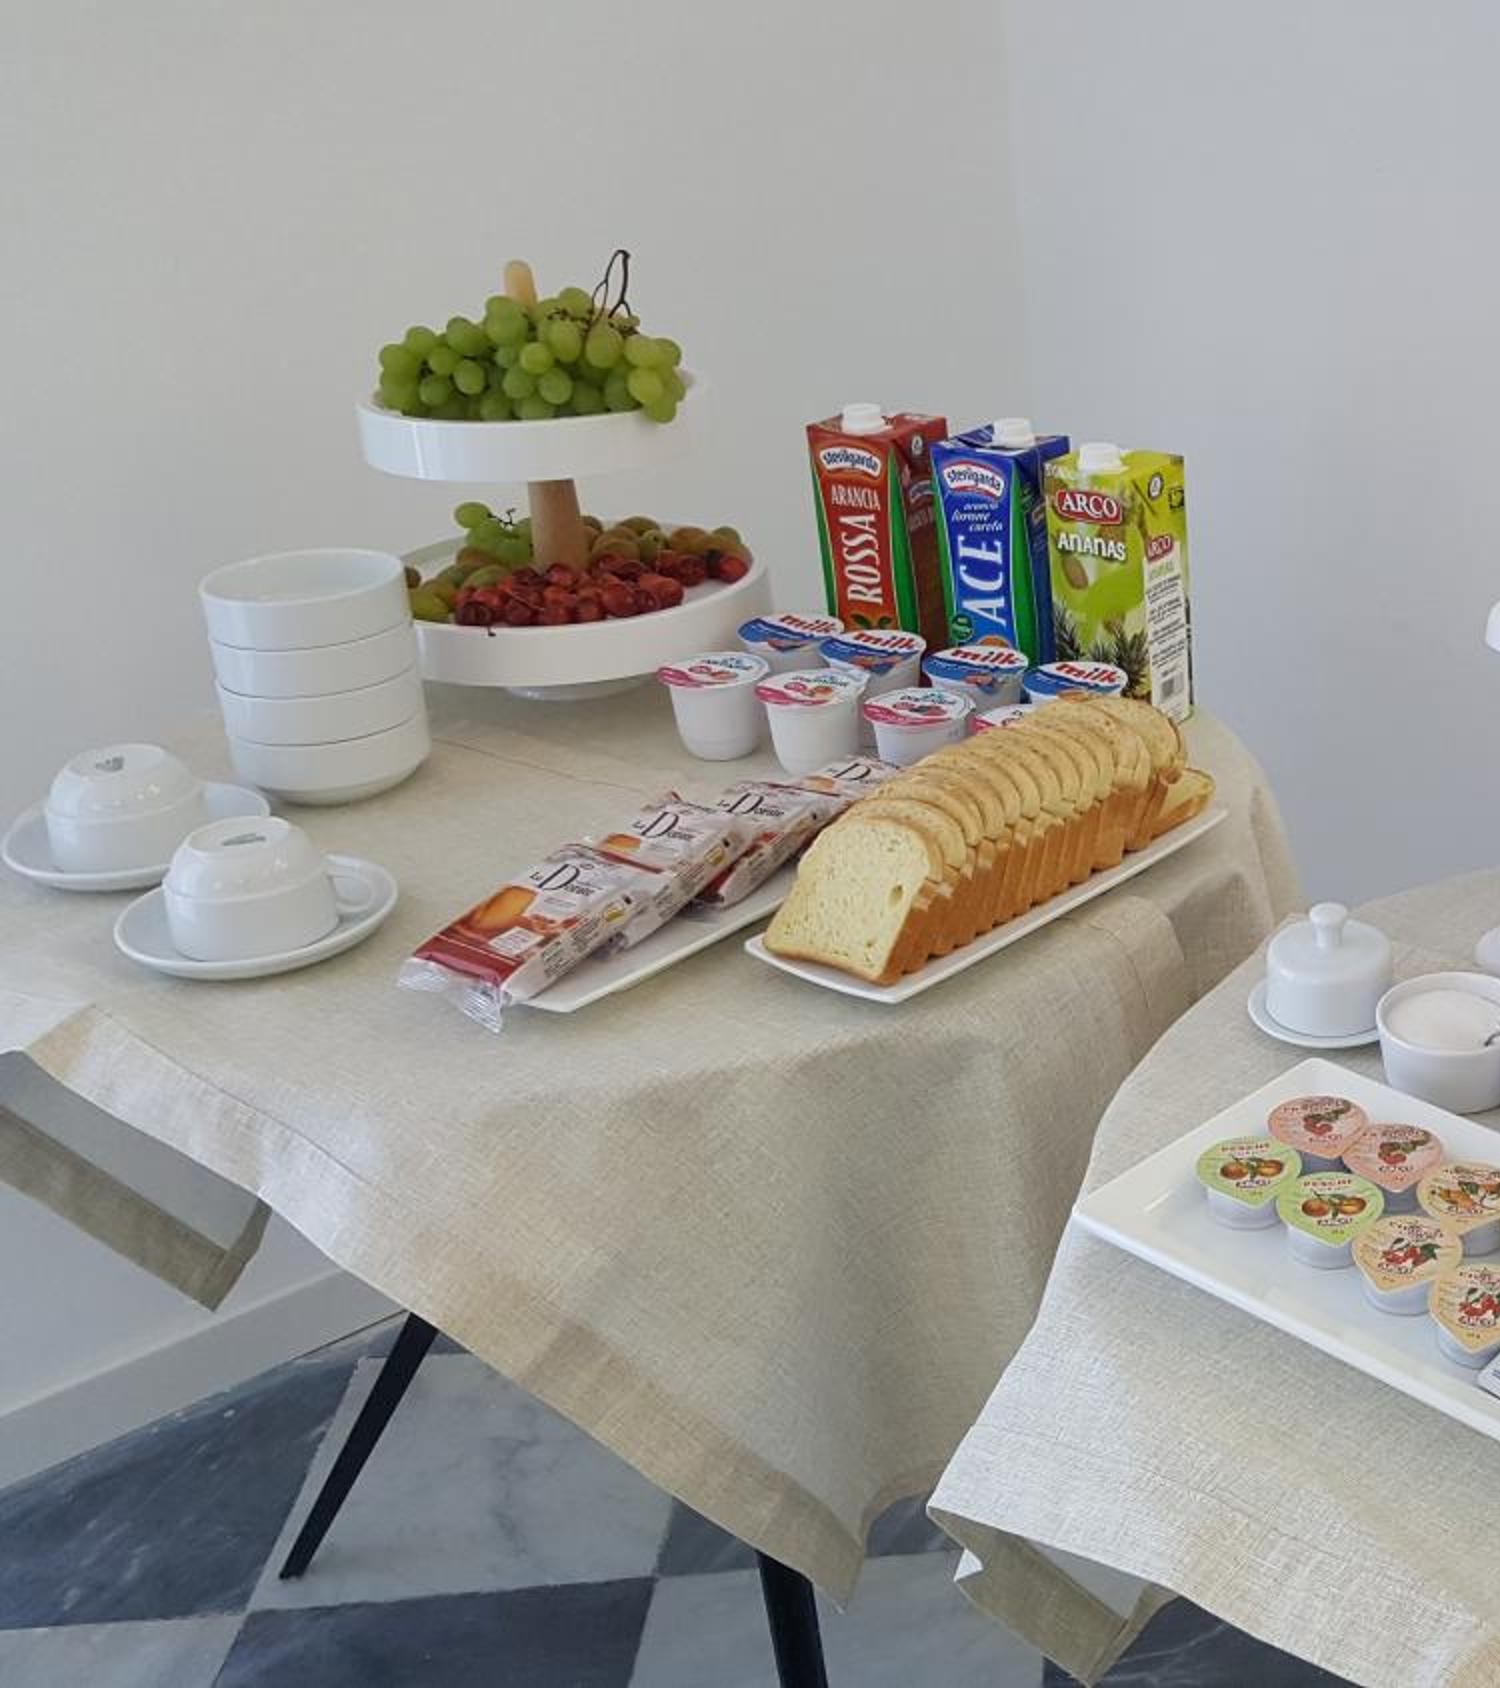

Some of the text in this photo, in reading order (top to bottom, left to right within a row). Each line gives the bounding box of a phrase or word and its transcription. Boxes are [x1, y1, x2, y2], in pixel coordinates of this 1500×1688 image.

[831, 484, 881, 511] ARANCIA
[1061, 492, 1118, 519] ARCO
[839, 514, 883, 605] ROSSA
[1057, 531, 1127, 561] ANANAS
[957, 535, 1007, 627] ACE
[779, 614, 836, 634] milk
[854, 632, 915, 649] milk
[951, 649, 1020, 665] milk
[1055, 663, 1120, 682] milk
